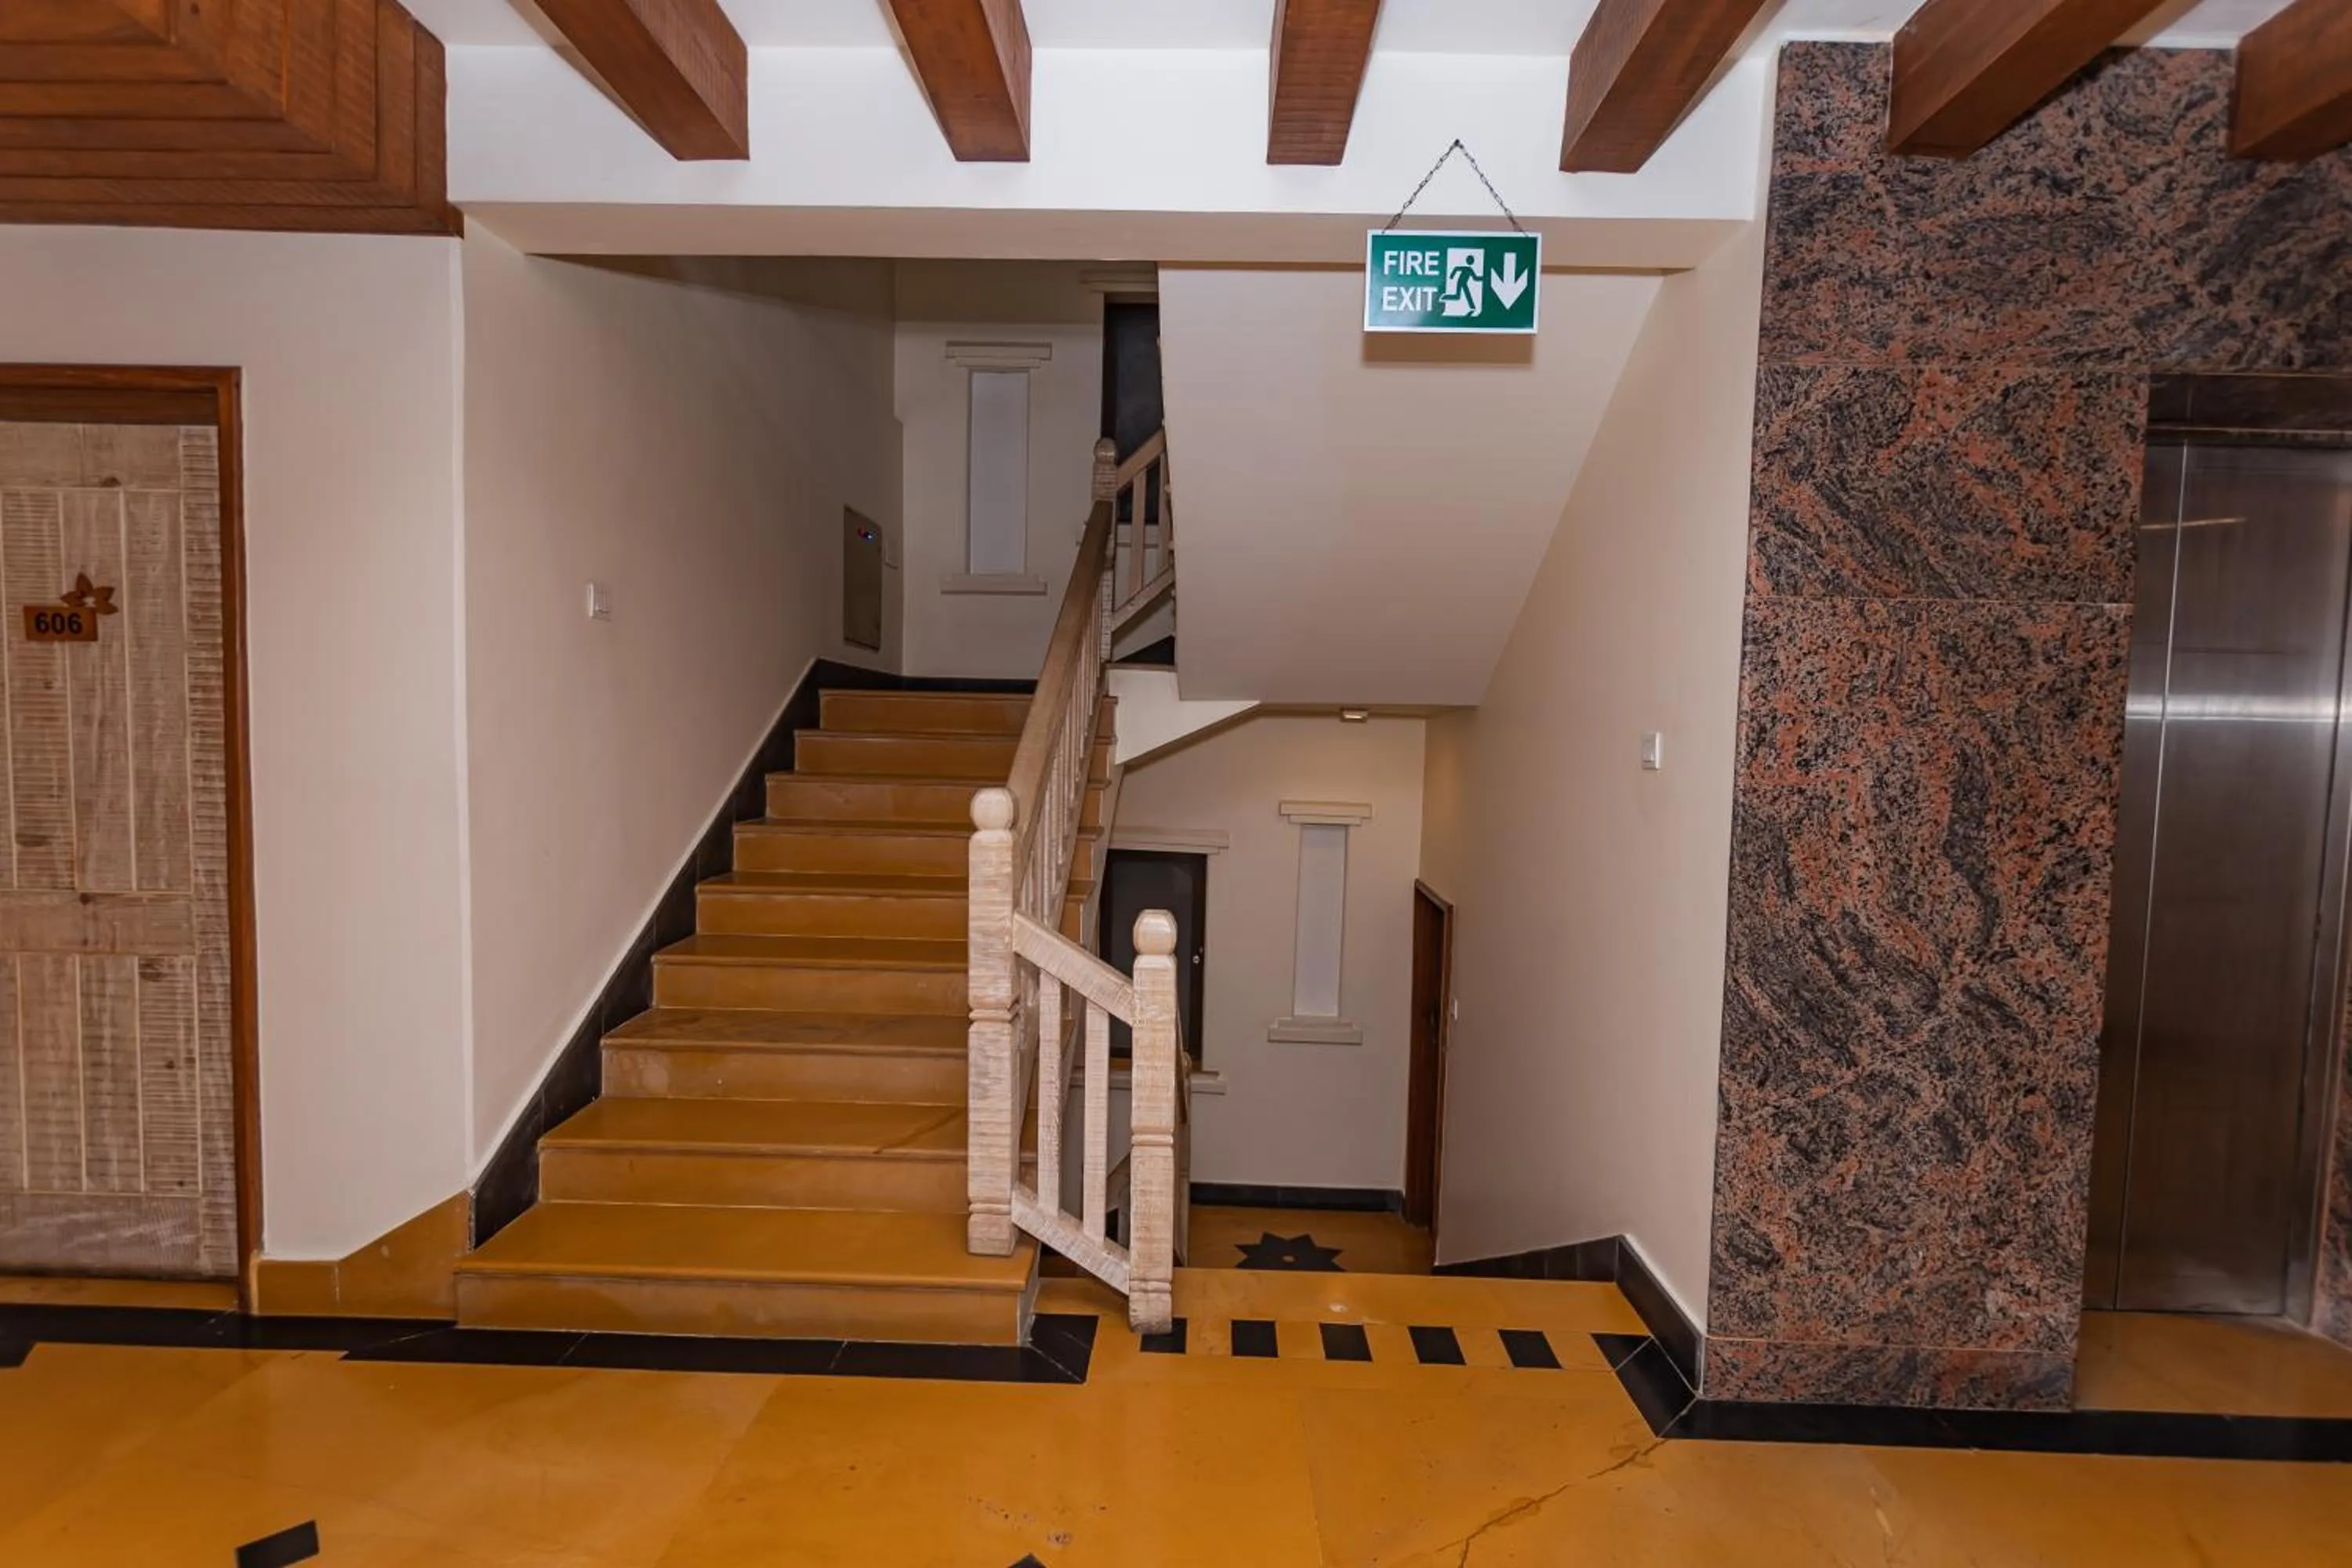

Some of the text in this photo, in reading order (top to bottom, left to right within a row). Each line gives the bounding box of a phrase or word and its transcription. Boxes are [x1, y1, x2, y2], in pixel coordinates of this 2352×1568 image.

[1383, 250, 1440, 275] FIRE
[1382, 286, 1438, 311] EXIT
[34, 612, 82, 635] 606
